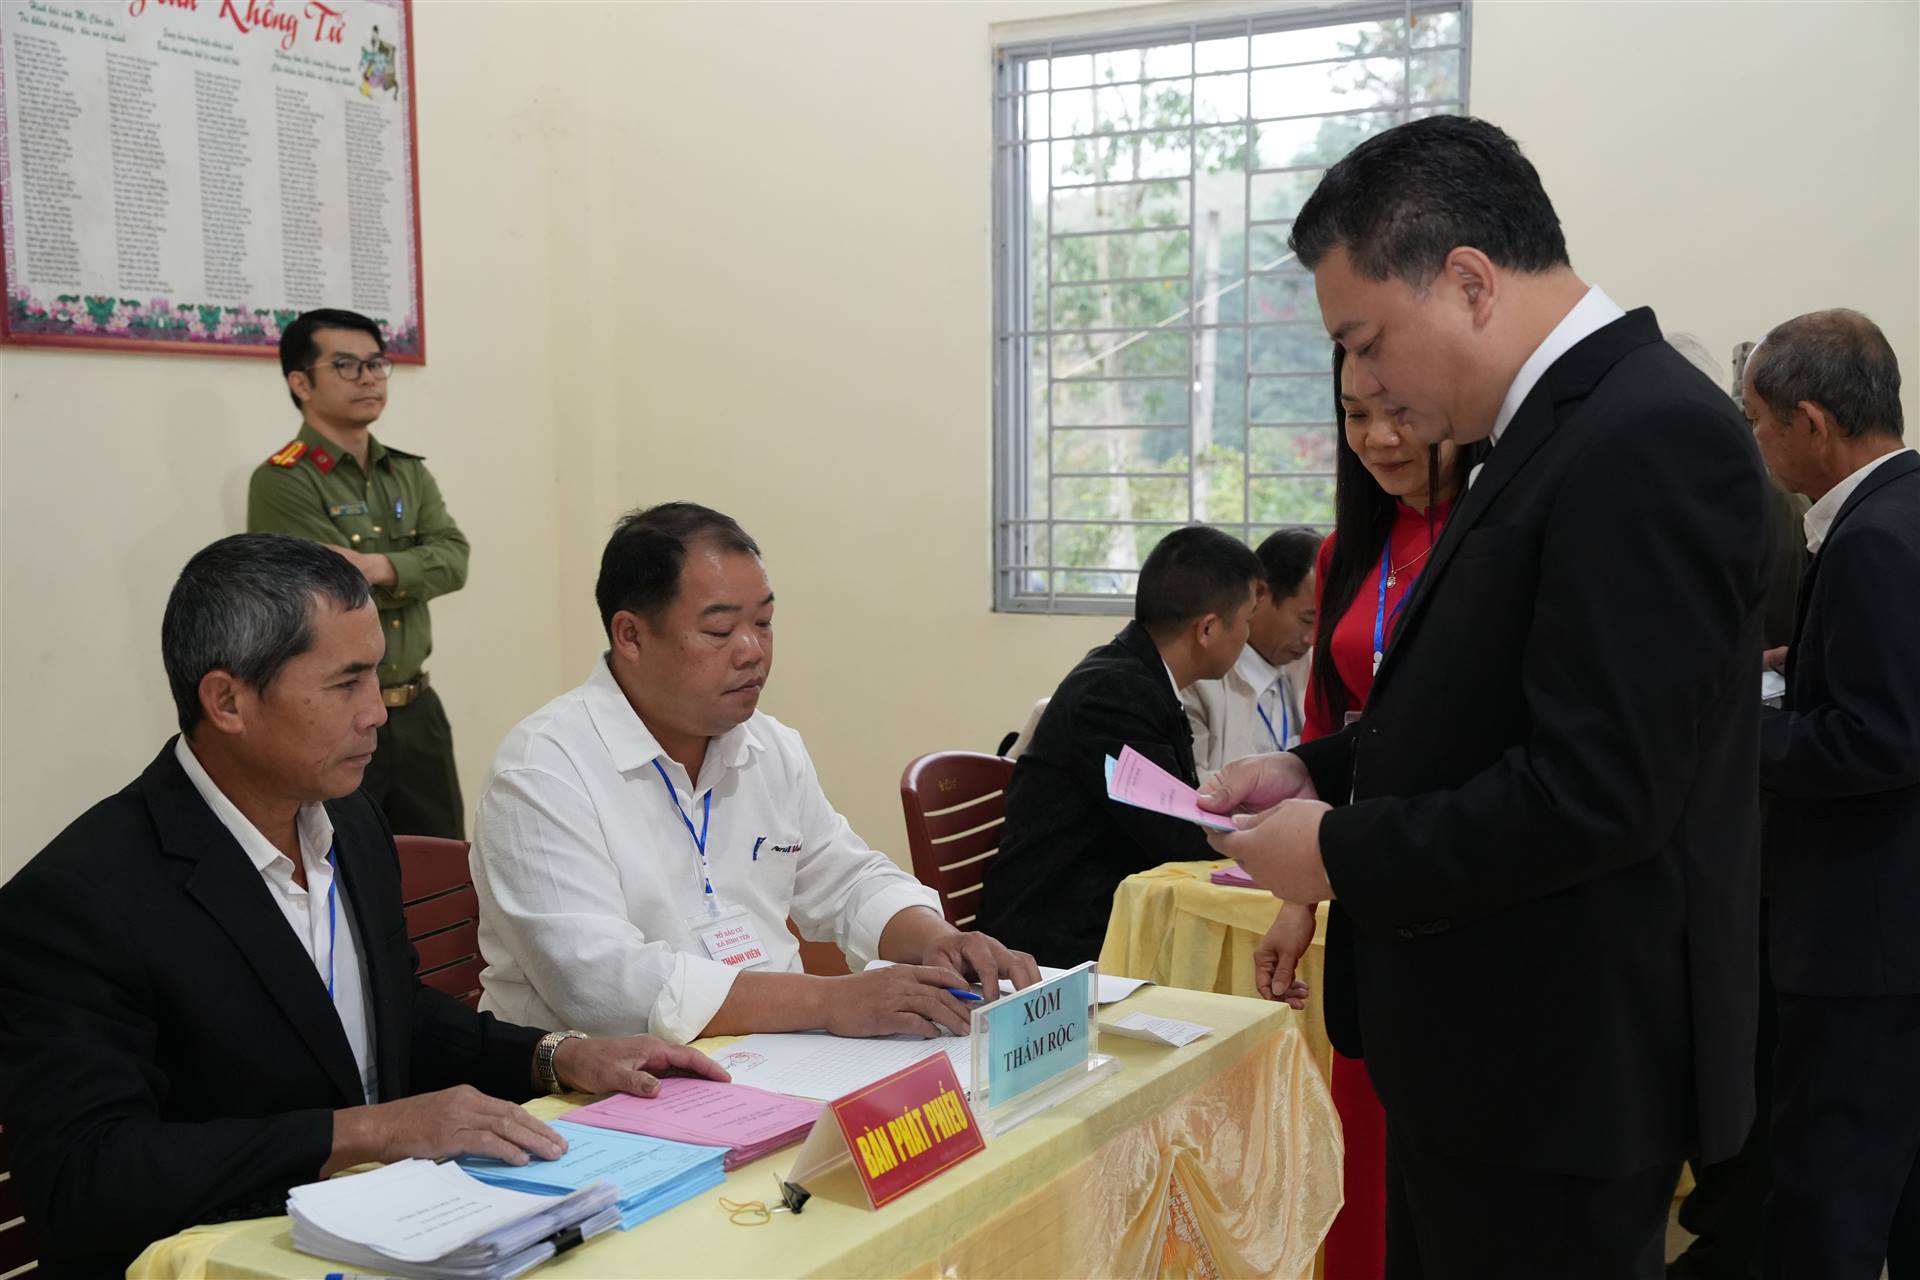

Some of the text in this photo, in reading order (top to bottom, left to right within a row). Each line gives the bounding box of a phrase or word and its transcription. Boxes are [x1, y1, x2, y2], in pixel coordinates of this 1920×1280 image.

[721, 947, 762, 966] THÀNH VIÊN
[1023, 988, 1062, 1026] XÓM
[1048, 1023, 1076, 1052] RỘC
[855, 1080, 969, 1180] BÀN PHÁT PHIẾU
